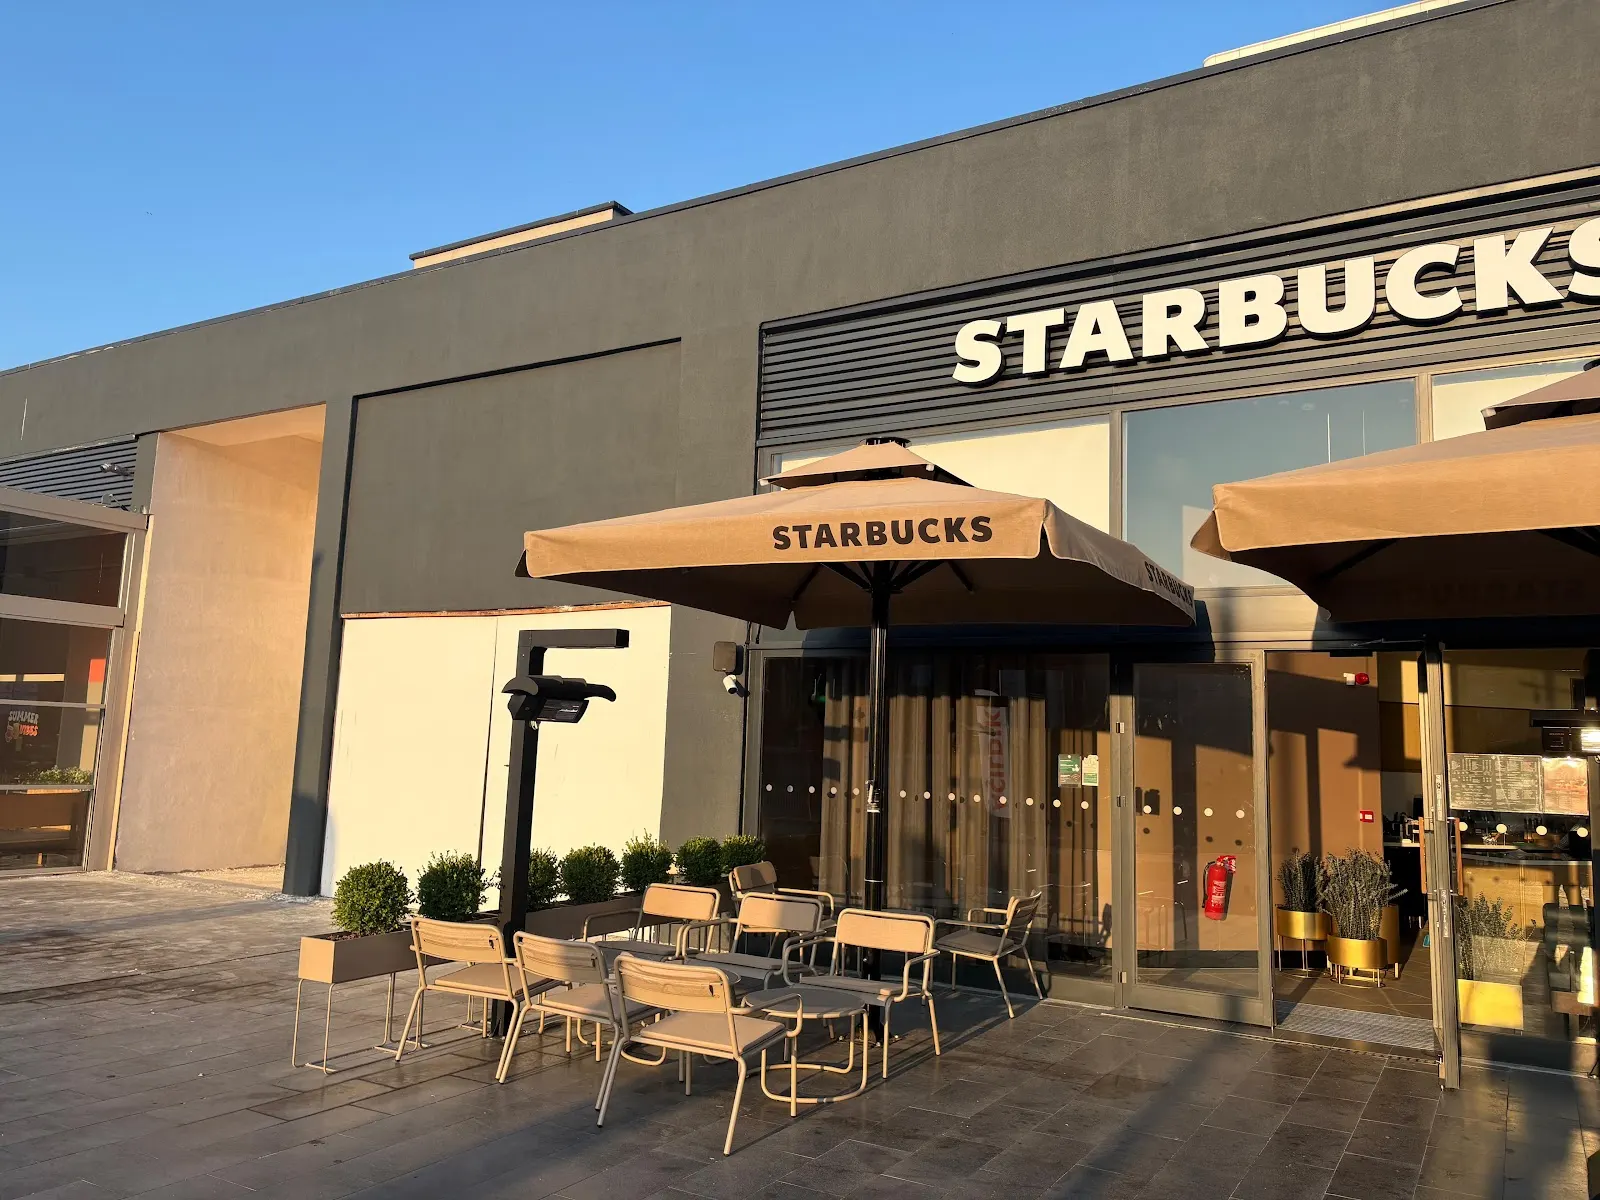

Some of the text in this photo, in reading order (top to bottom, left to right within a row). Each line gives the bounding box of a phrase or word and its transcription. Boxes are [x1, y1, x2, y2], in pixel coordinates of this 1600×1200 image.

[772, 515, 993, 550] STARBUCKS
[1144, 560, 1194, 609] STARBUCKS
[8, 710, 39, 725] SUMMER
